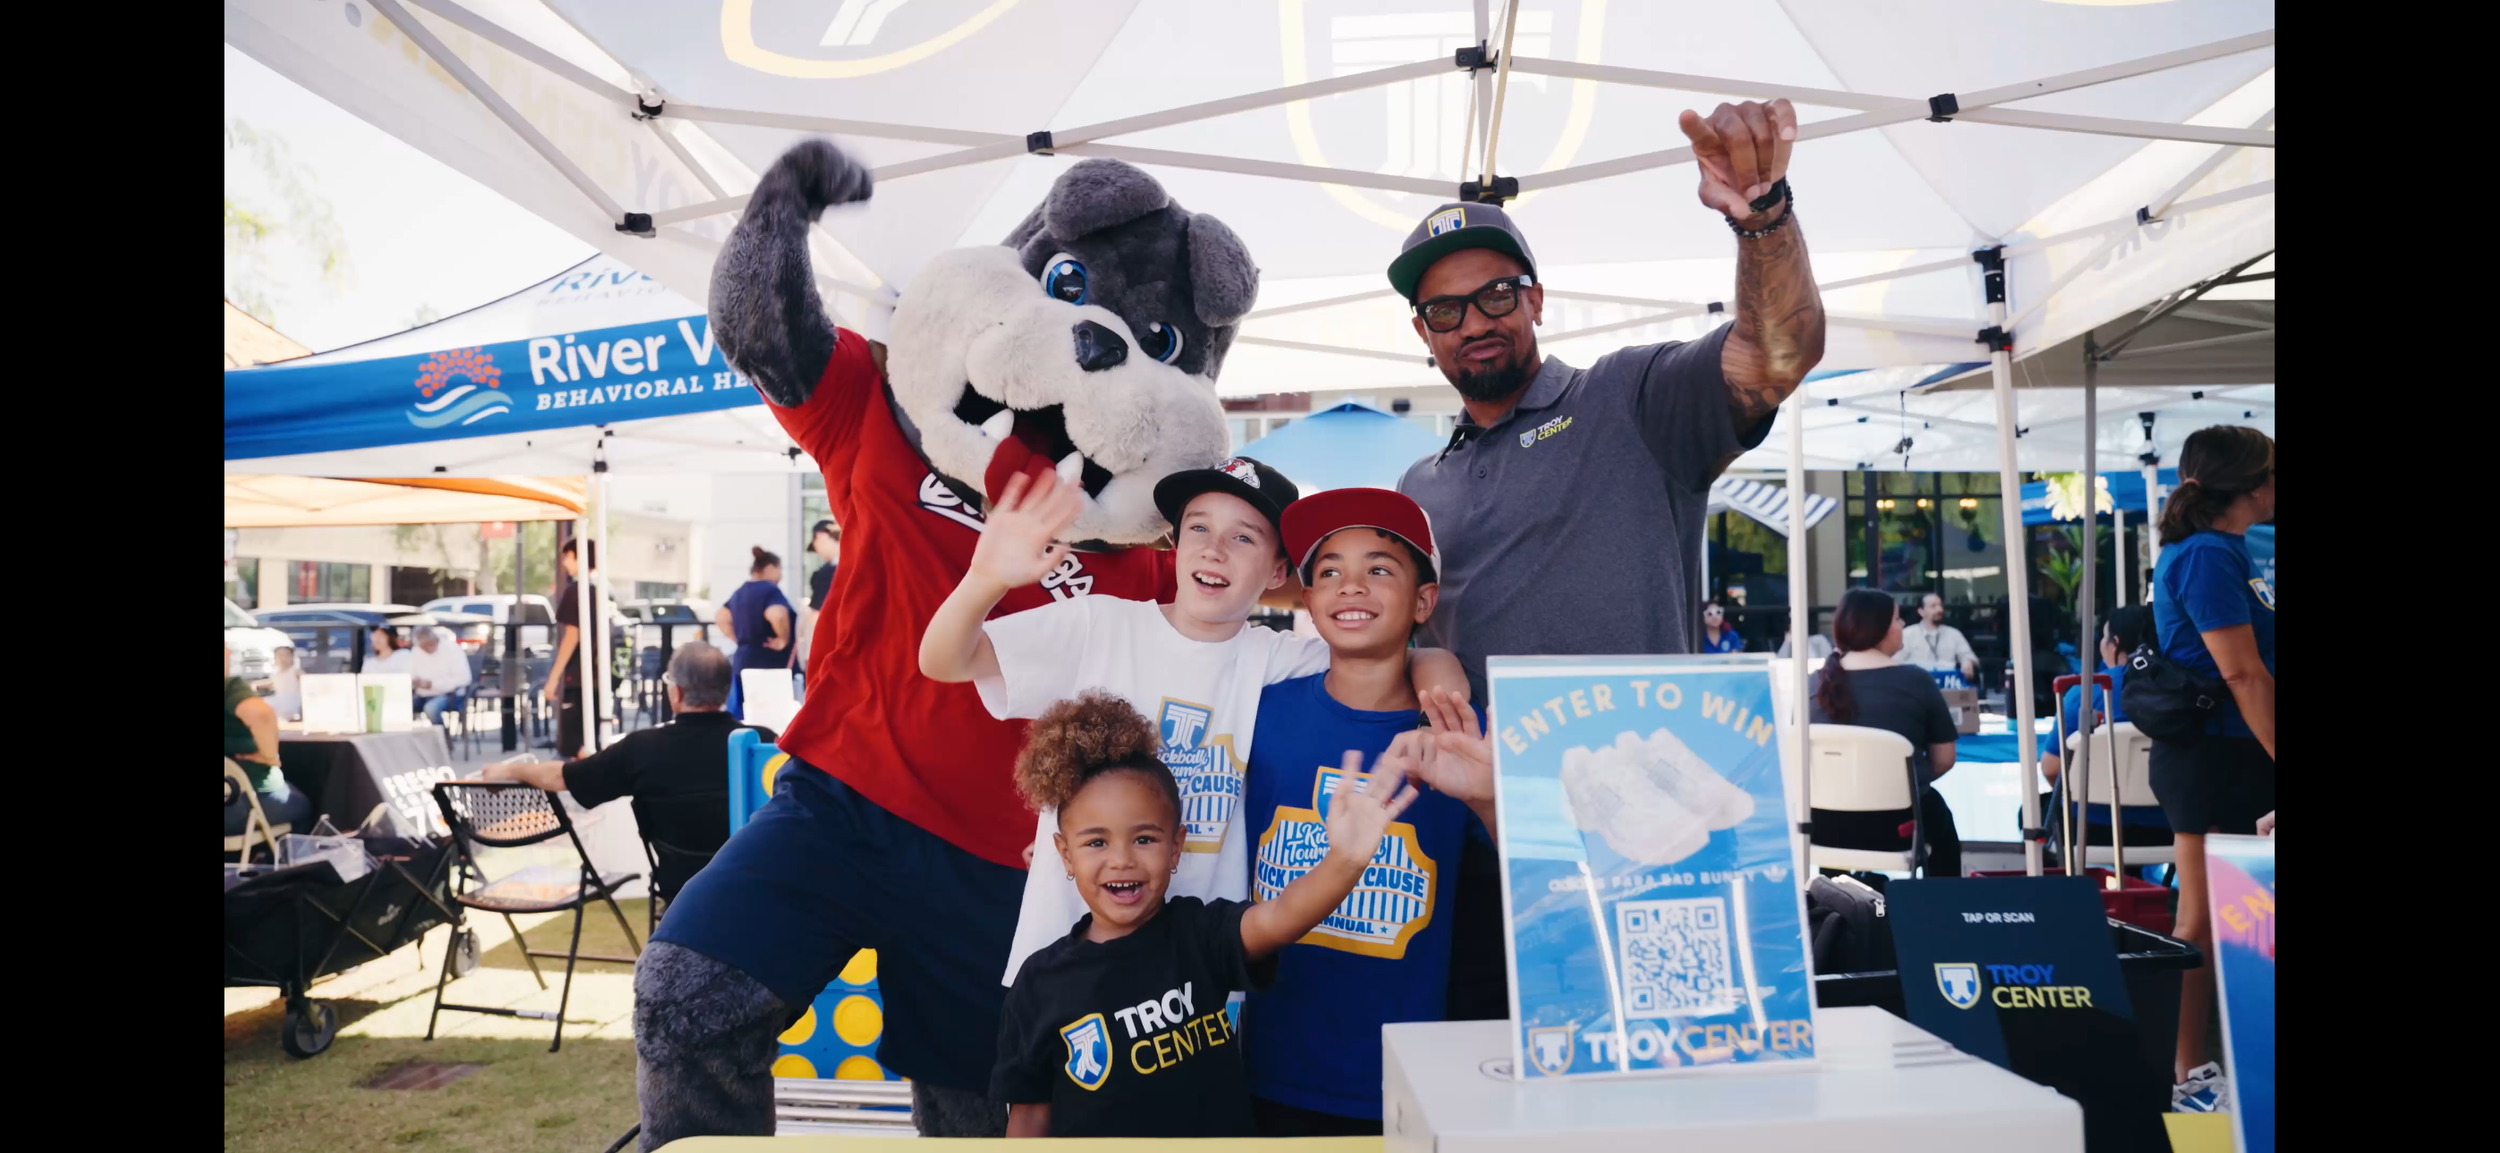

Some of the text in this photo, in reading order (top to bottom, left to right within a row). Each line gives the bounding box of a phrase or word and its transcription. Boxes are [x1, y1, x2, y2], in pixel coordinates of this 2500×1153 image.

[529, 334, 667, 386] River
[536, 371, 753, 411] BEHAVIORAL HE
[1537, 415, 1563, 433] TROY
[1538, 416, 1573, 441] CENTER
[1501, 680, 1774, 756] ENTER TO WIN
[1191, 774, 1242, 797] CAUSE
[1257, 858, 1286, 889] KICK
[1363, 866, 1425, 898] CAUSE
[1961, 912, 2036, 924] TAP OR SCAN
[1985, 964, 2055, 985] TROY
[1114, 981, 1195, 1039] TROY
[1991, 985, 2093, 1008] CENTER
